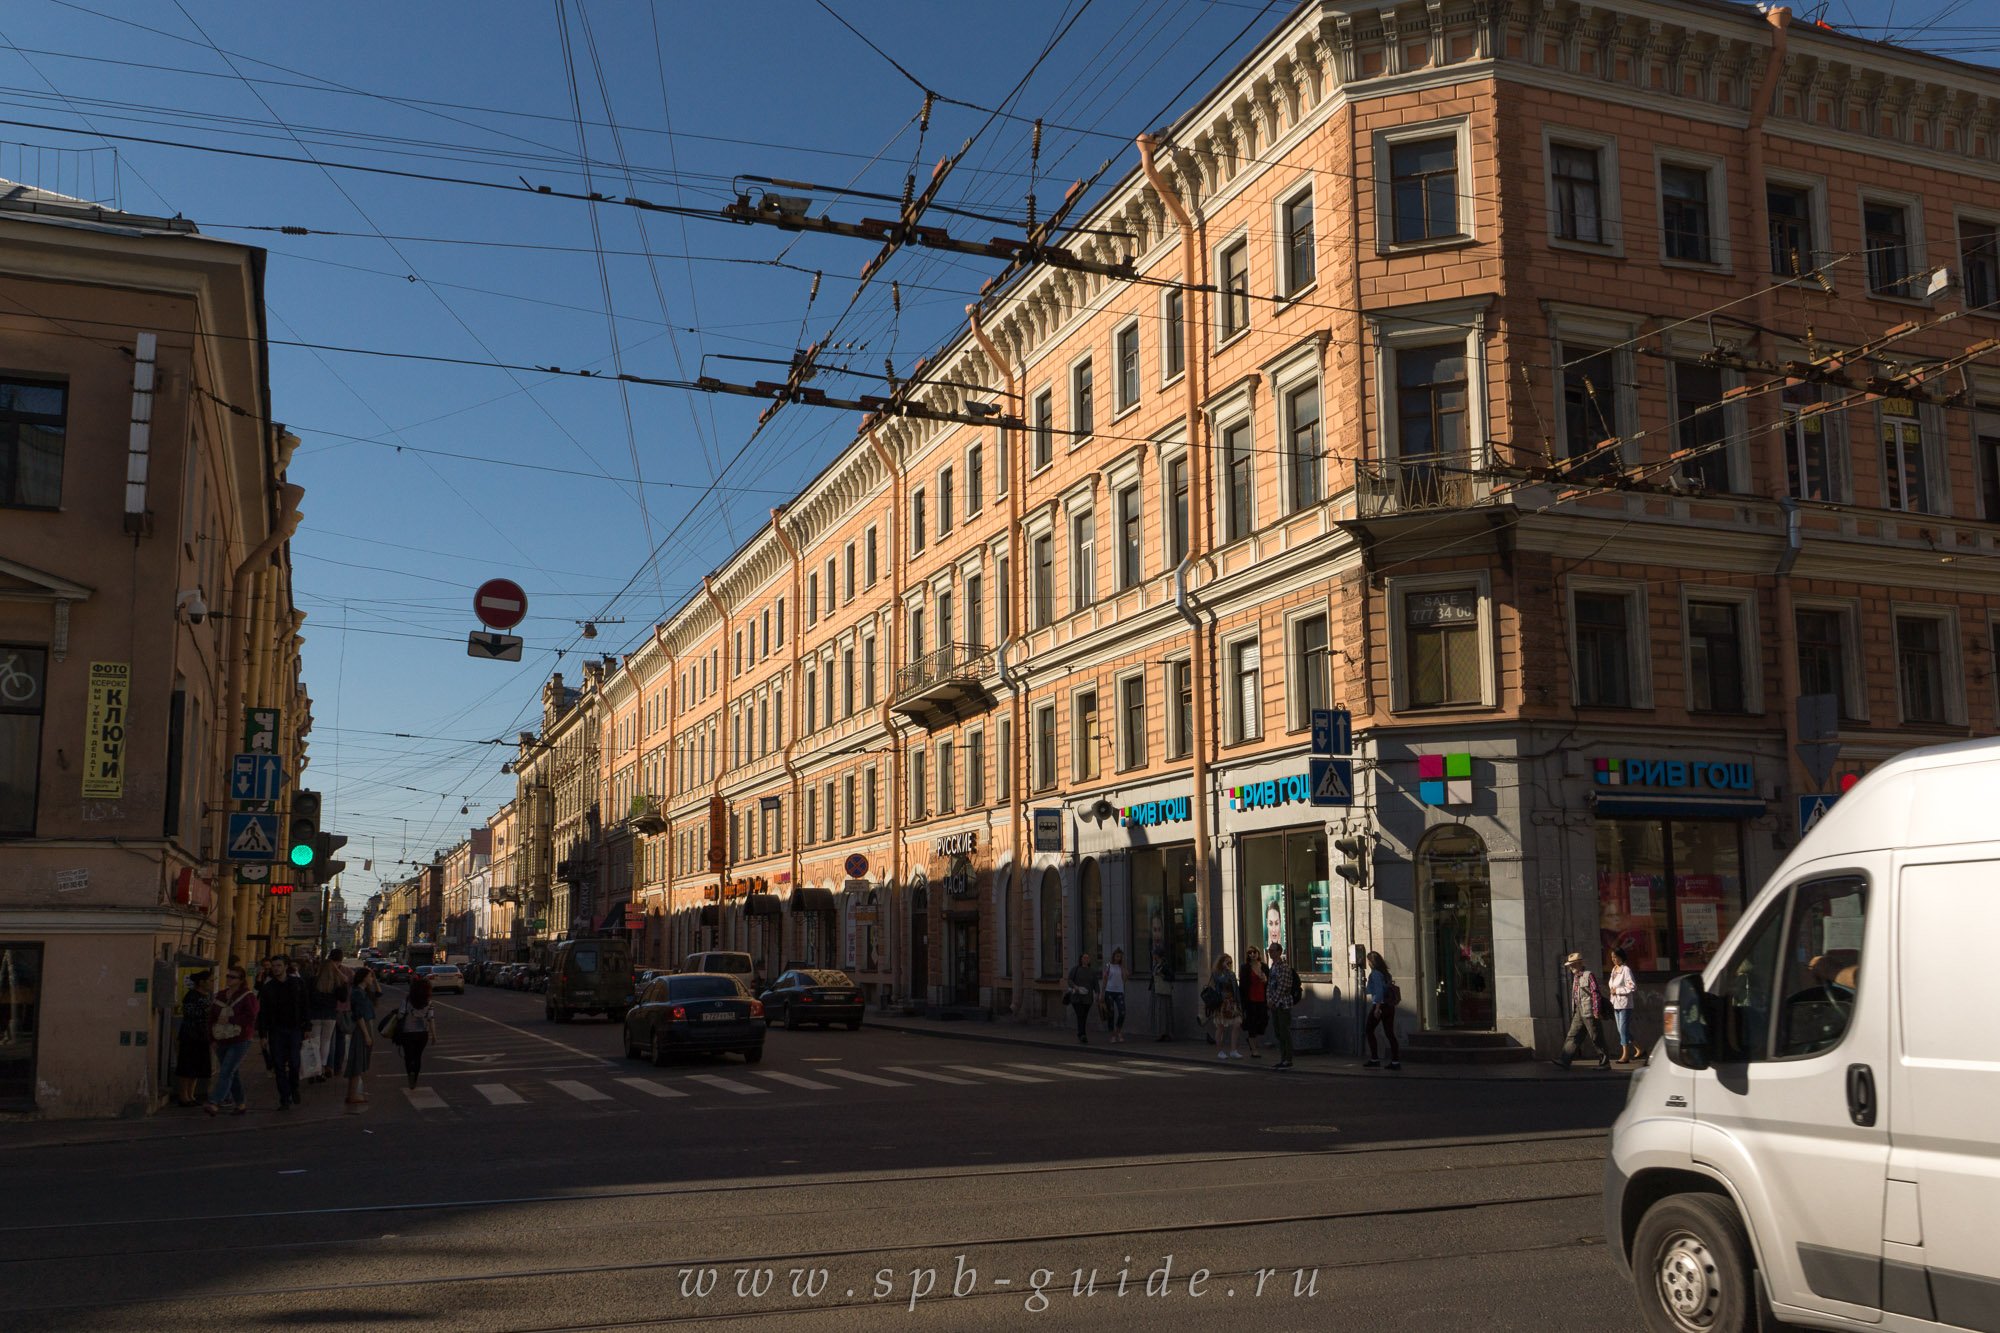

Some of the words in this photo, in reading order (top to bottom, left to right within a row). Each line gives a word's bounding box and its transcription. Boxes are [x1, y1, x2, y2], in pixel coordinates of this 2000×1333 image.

[1424, 595, 1458, 606] SALE
[1411, 609, 1433, 621] 777
[1438, 607, 1452, 619] 34
[1456, 606, 1472, 617] 00
[92, 664, 127, 674] ФОТО
[91, 679, 127, 687] КСЕРОКС
[102, 688, 123, 778] КЛЮЧИ
[1626, 758, 1686, 787] РИВ
[1693, 760, 1753, 790] ГОШ
[1243, 780, 1276, 809] РИВ
[1131, 802, 1157, 826] РИВ
[1159, 796, 1187, 821] ГОШ
[937, 832, 972, 858] РУССКИЕ
[943, 874, 965, 895] ЧАСЫ
